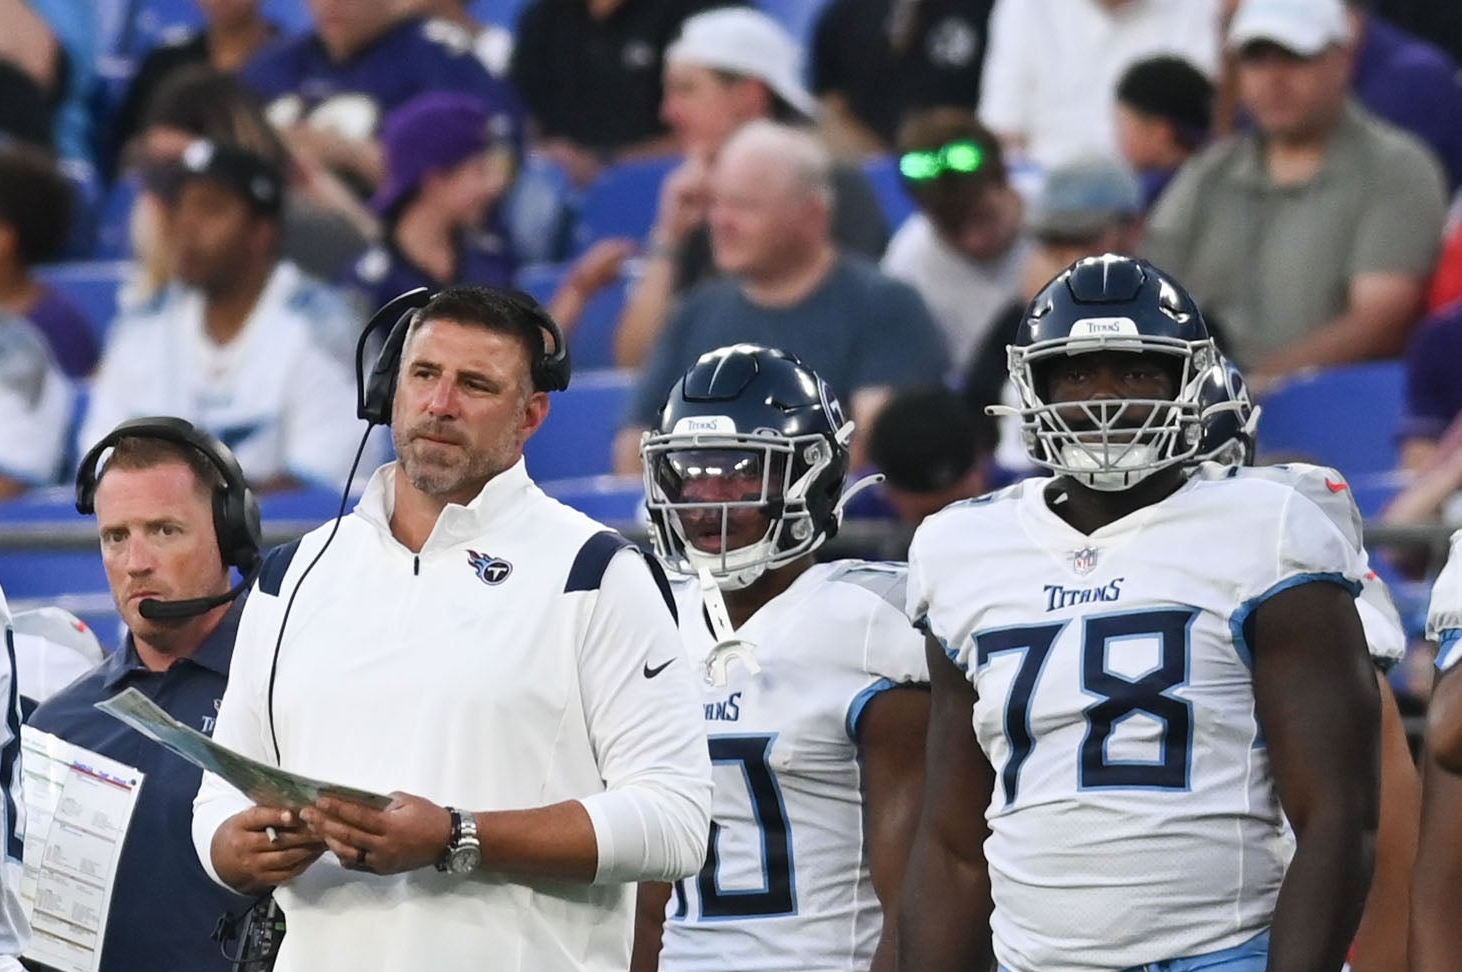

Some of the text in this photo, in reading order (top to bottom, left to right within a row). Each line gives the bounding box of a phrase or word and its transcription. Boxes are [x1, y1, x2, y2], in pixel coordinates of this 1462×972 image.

[1086, 321, 1121, 333] TITANS
[1043, 578, 1125, 612] TITANS
[970, 606, 1203, 813] 78
